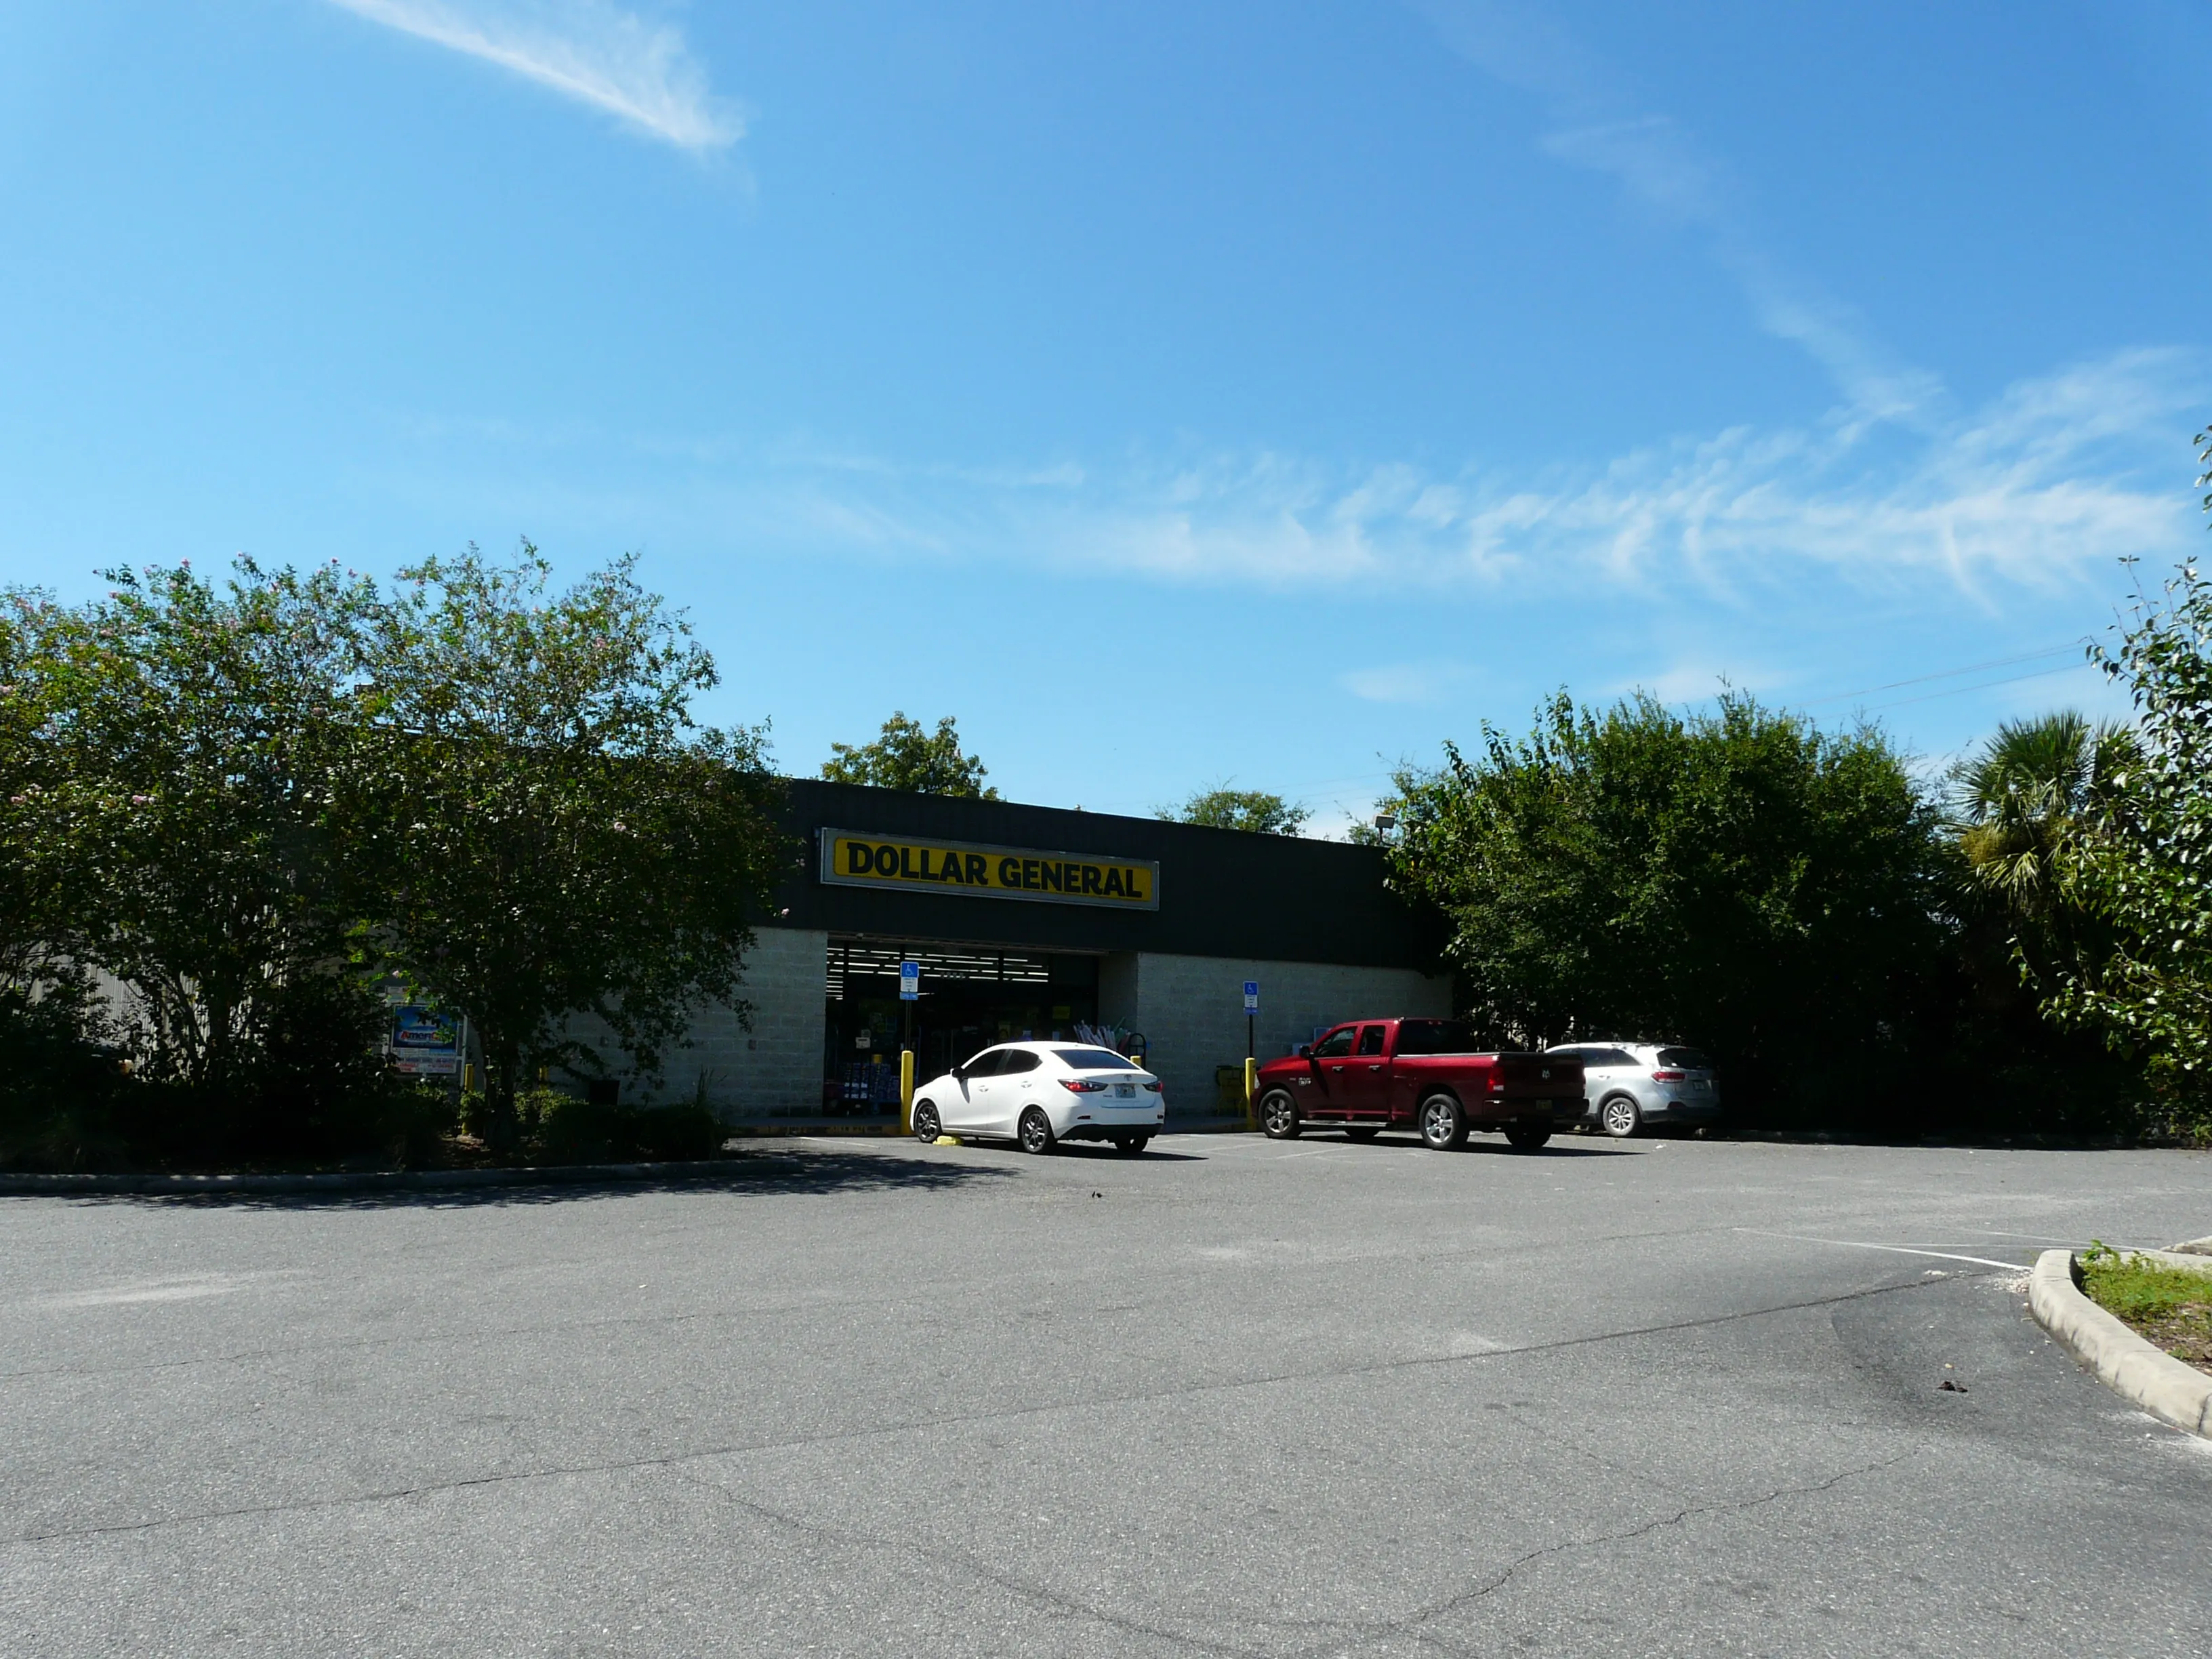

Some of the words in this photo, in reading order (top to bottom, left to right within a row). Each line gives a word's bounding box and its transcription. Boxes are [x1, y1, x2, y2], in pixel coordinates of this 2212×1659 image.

[847, 842, 988, 885] DOLLAR
[998, 858, 1143, 897] GENERAL
[401, 1030, 448, 1040] Ameri
